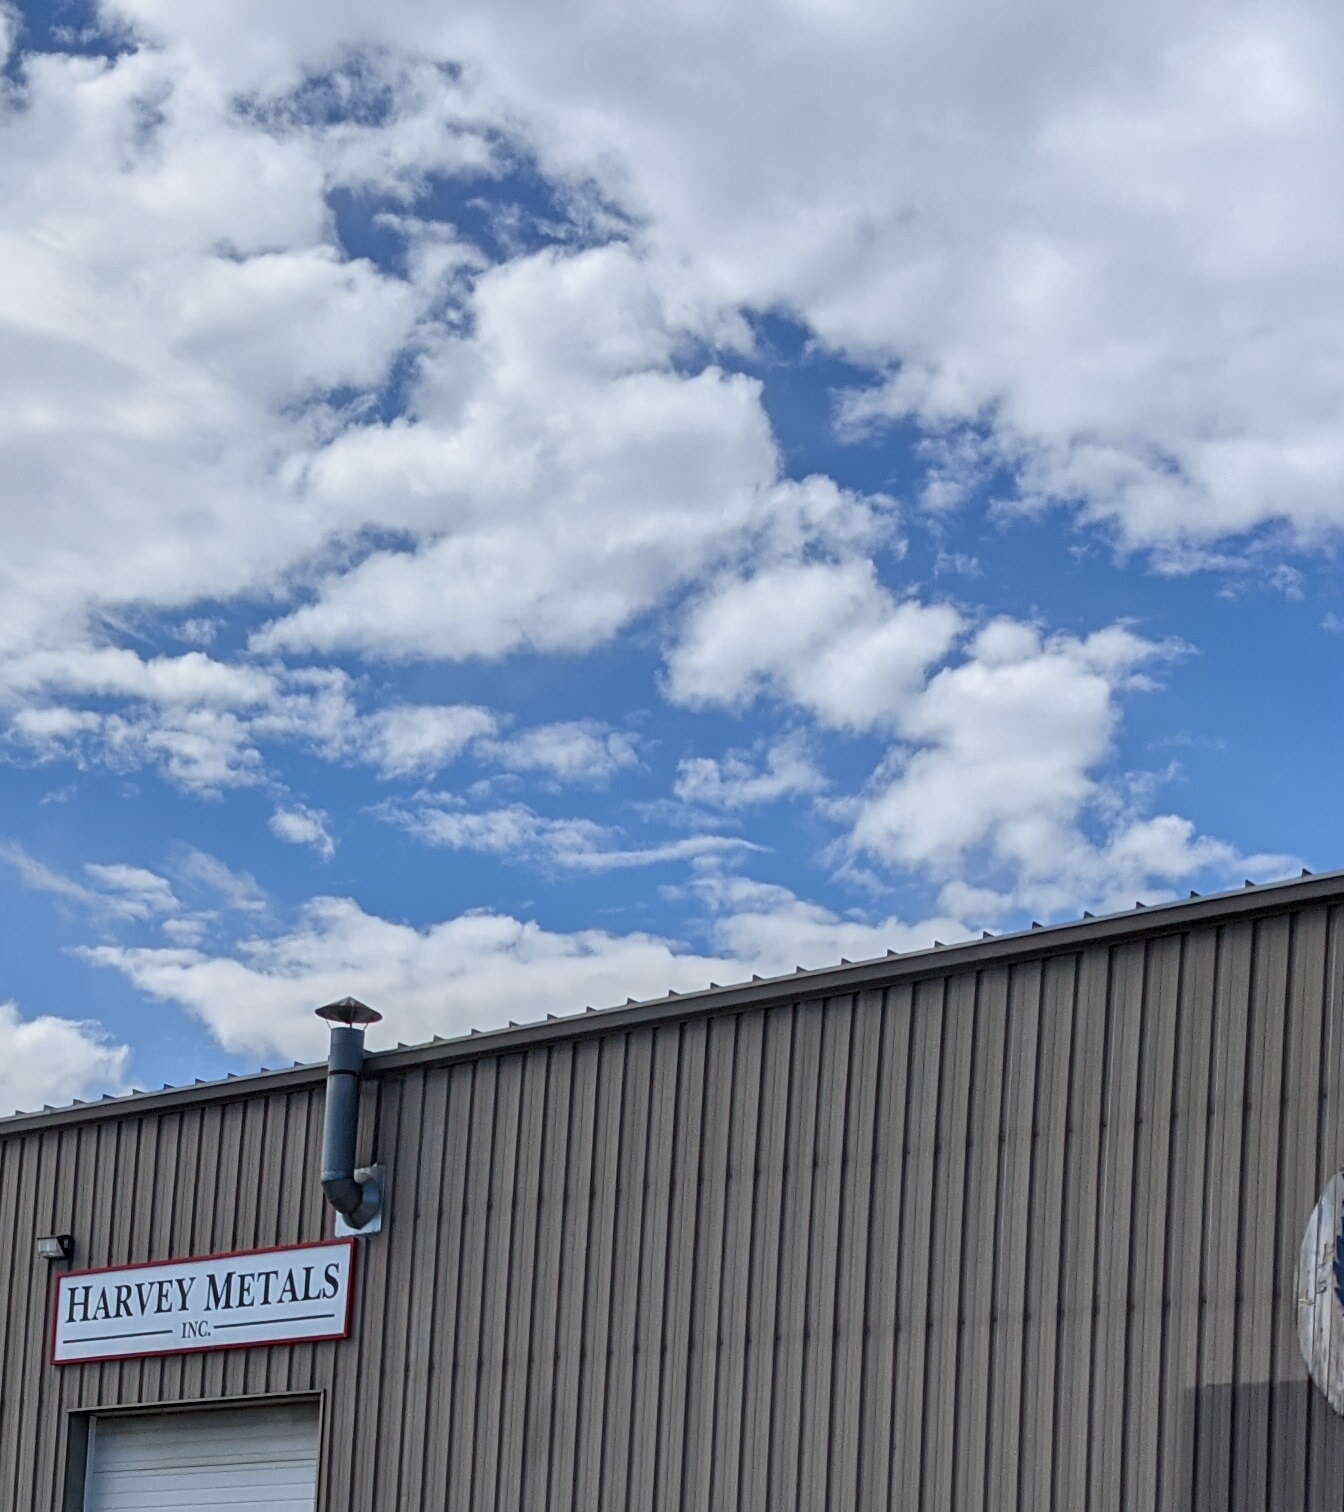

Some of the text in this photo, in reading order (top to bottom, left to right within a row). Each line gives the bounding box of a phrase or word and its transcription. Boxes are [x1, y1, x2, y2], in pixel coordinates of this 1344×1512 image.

[65, 1262, 340, 1323] HARVEY METALS
[181, 1320, 211, 1339] INC.
